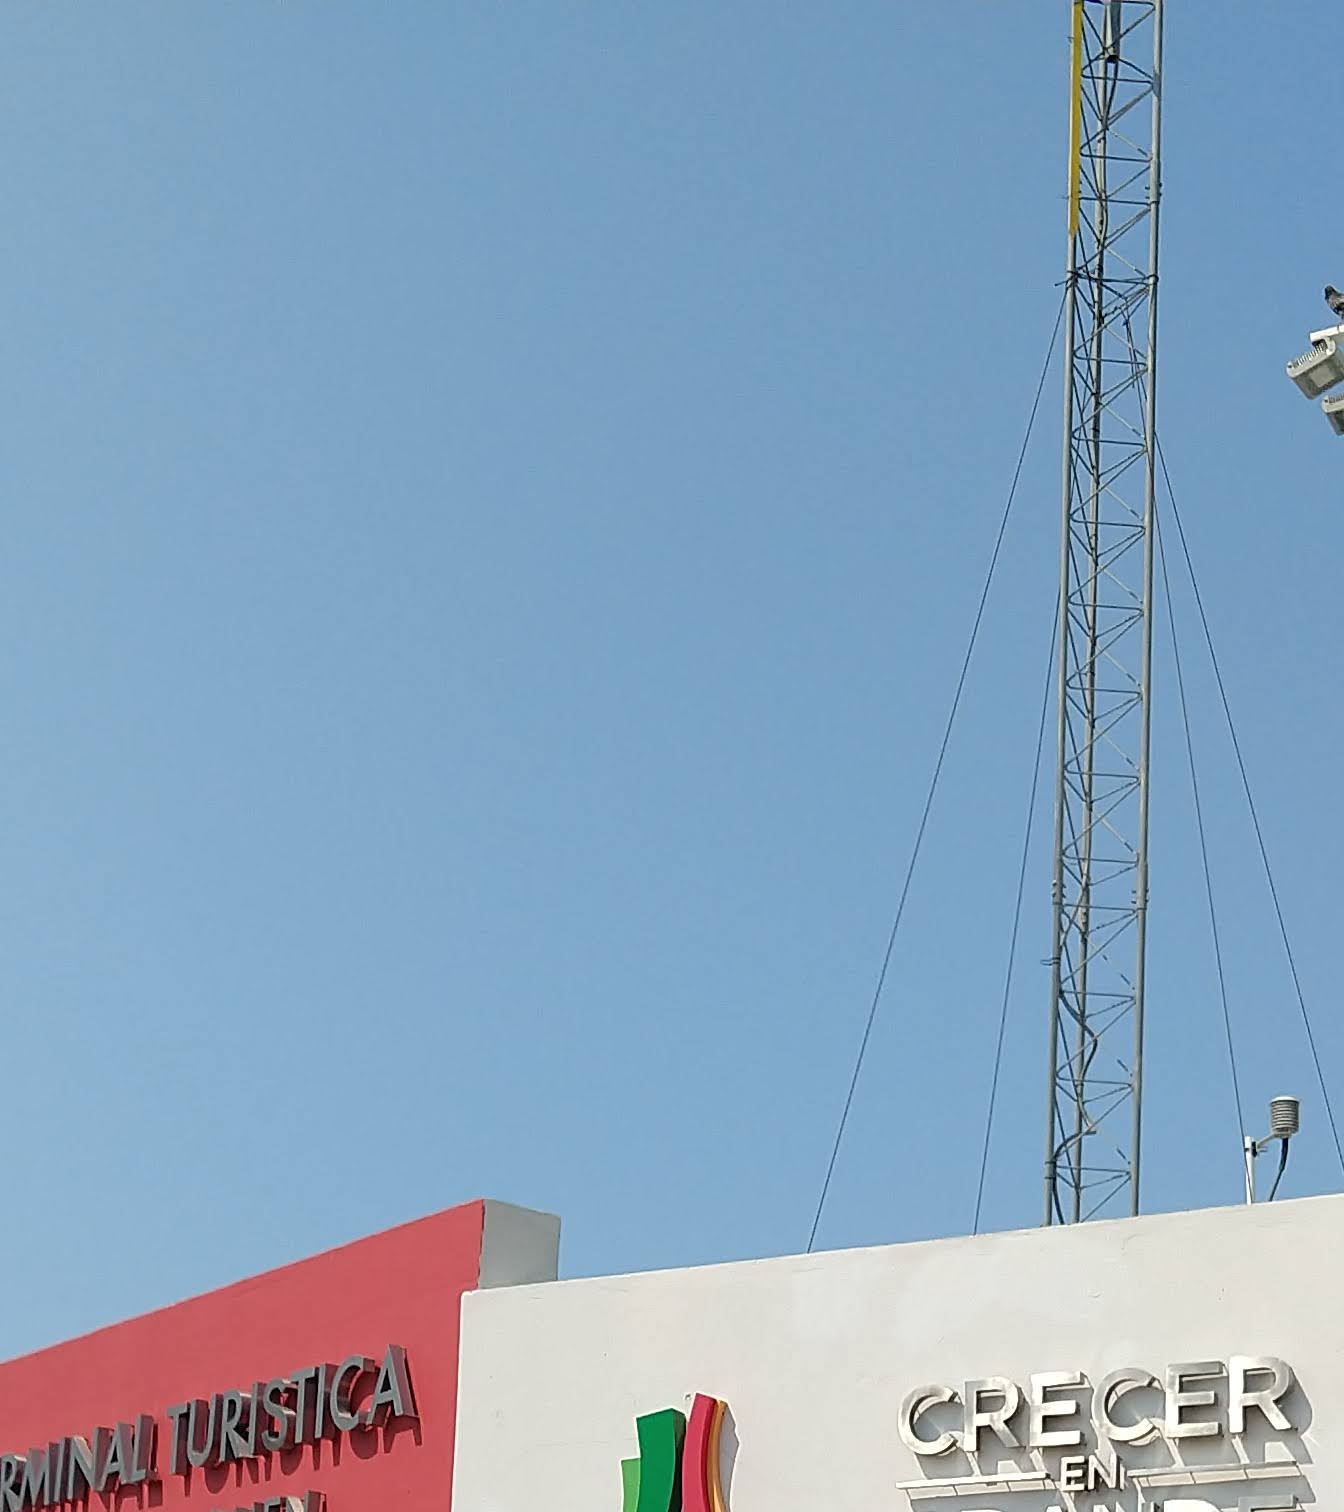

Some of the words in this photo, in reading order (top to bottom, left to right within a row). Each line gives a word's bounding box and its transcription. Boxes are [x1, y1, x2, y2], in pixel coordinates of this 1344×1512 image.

[166, 1343, 421, 1476] TURISTICA
[897, 1355, 1299, 1455] CRECER
[1059, 1453, 1125, 1493] EN
